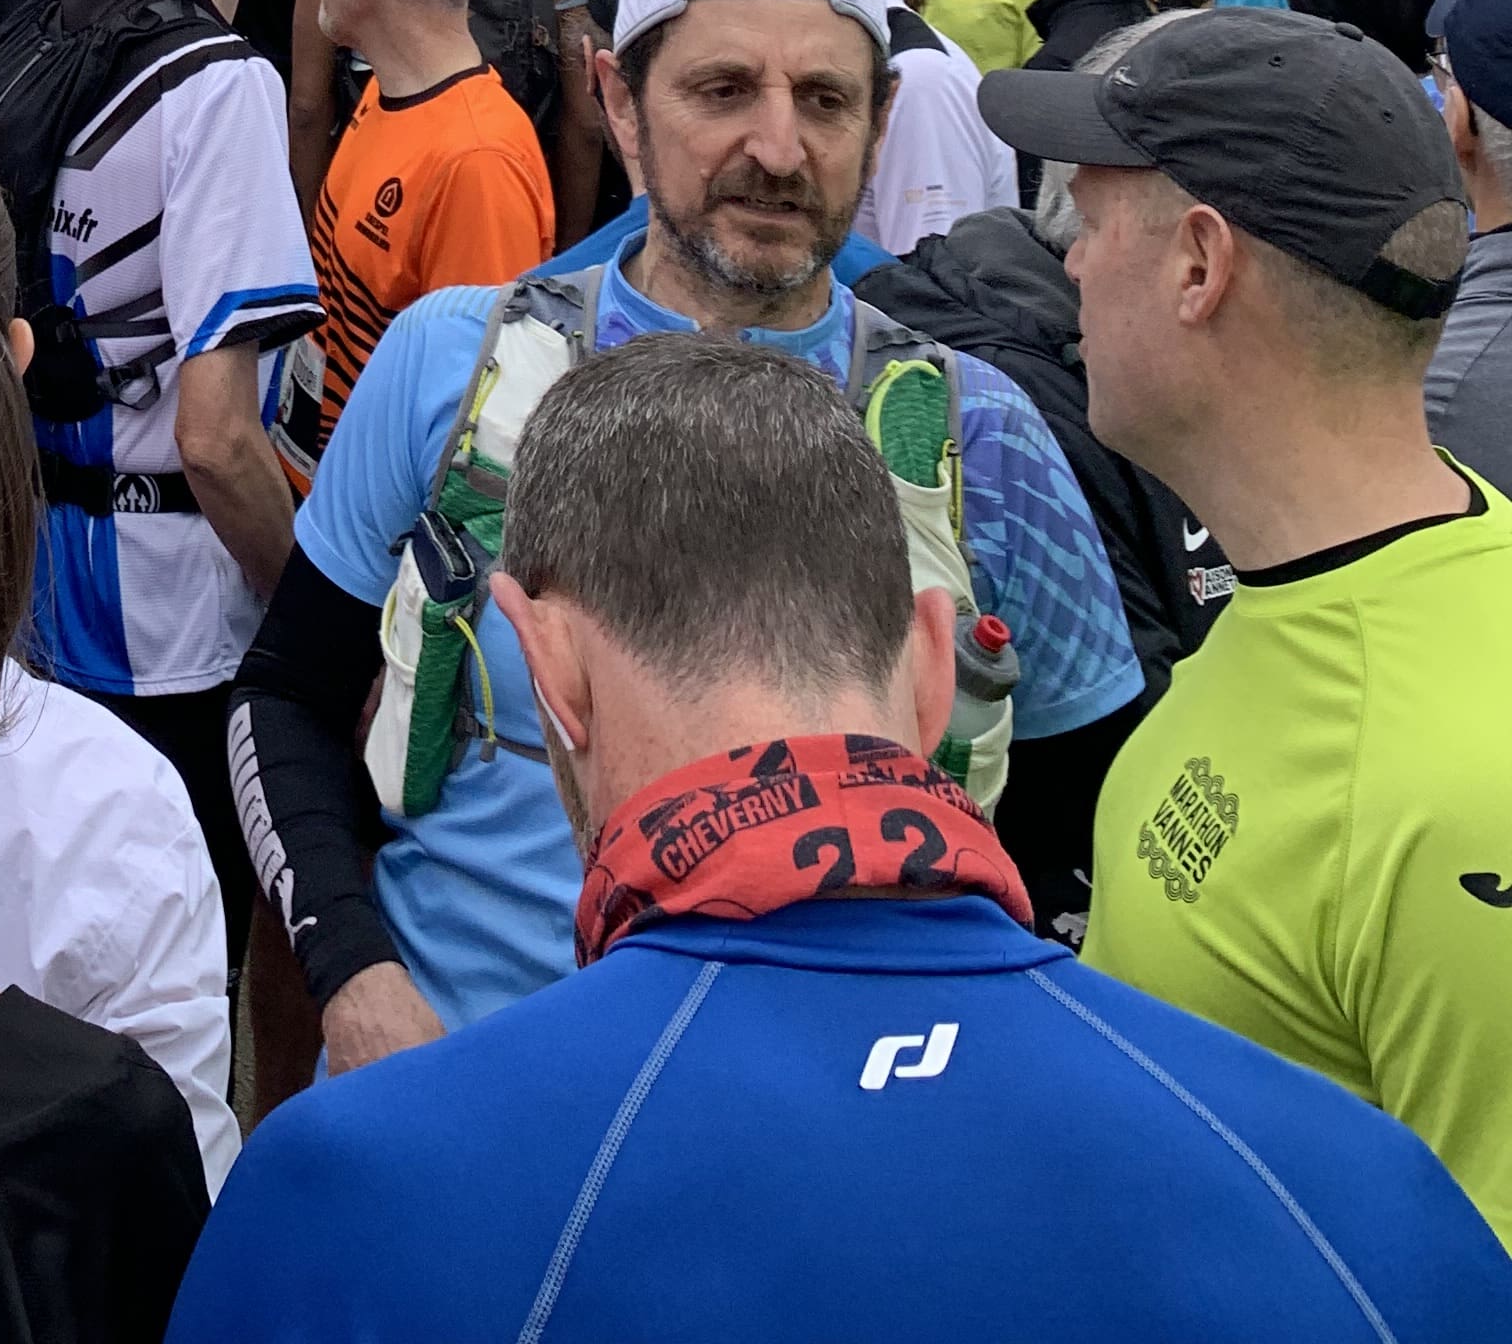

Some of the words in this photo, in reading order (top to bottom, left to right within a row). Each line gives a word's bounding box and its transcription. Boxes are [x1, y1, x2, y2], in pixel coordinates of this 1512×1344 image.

[660, 777, 805, 879] CHEVERNY
[1152, 797, 1212, 885] VANNES
[1170, 772, 1230, 859] MARATHON
